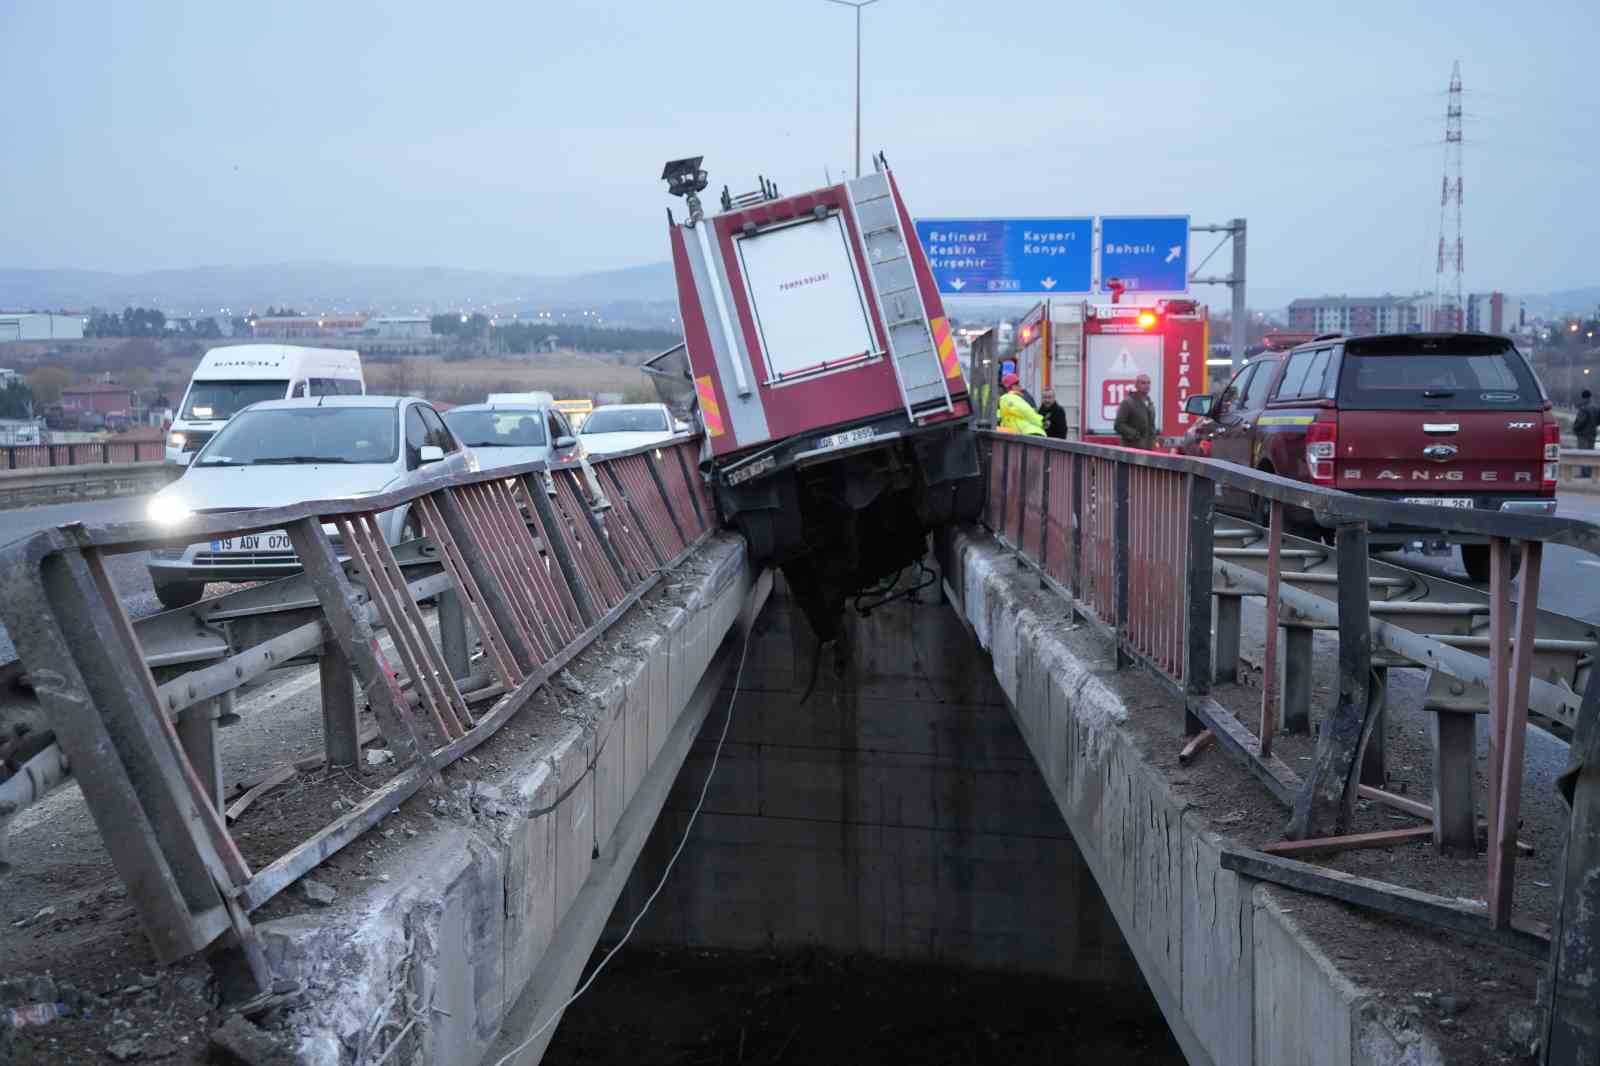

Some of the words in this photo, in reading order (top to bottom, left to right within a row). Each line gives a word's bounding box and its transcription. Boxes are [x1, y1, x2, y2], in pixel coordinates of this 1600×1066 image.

[930, 231, 987, 242] Rafineri
[1024, 231, 1076, 243] Kayseri
[930, 244, 976, 255] Keskin
[1024, 244, 1067, 256] Konya
[1344, 469, 1532, 481] RANGER
[222, 537, 232, 550] 19
[240, 535, 260, 549] ADV
[268, 535, 290, 549] 070
